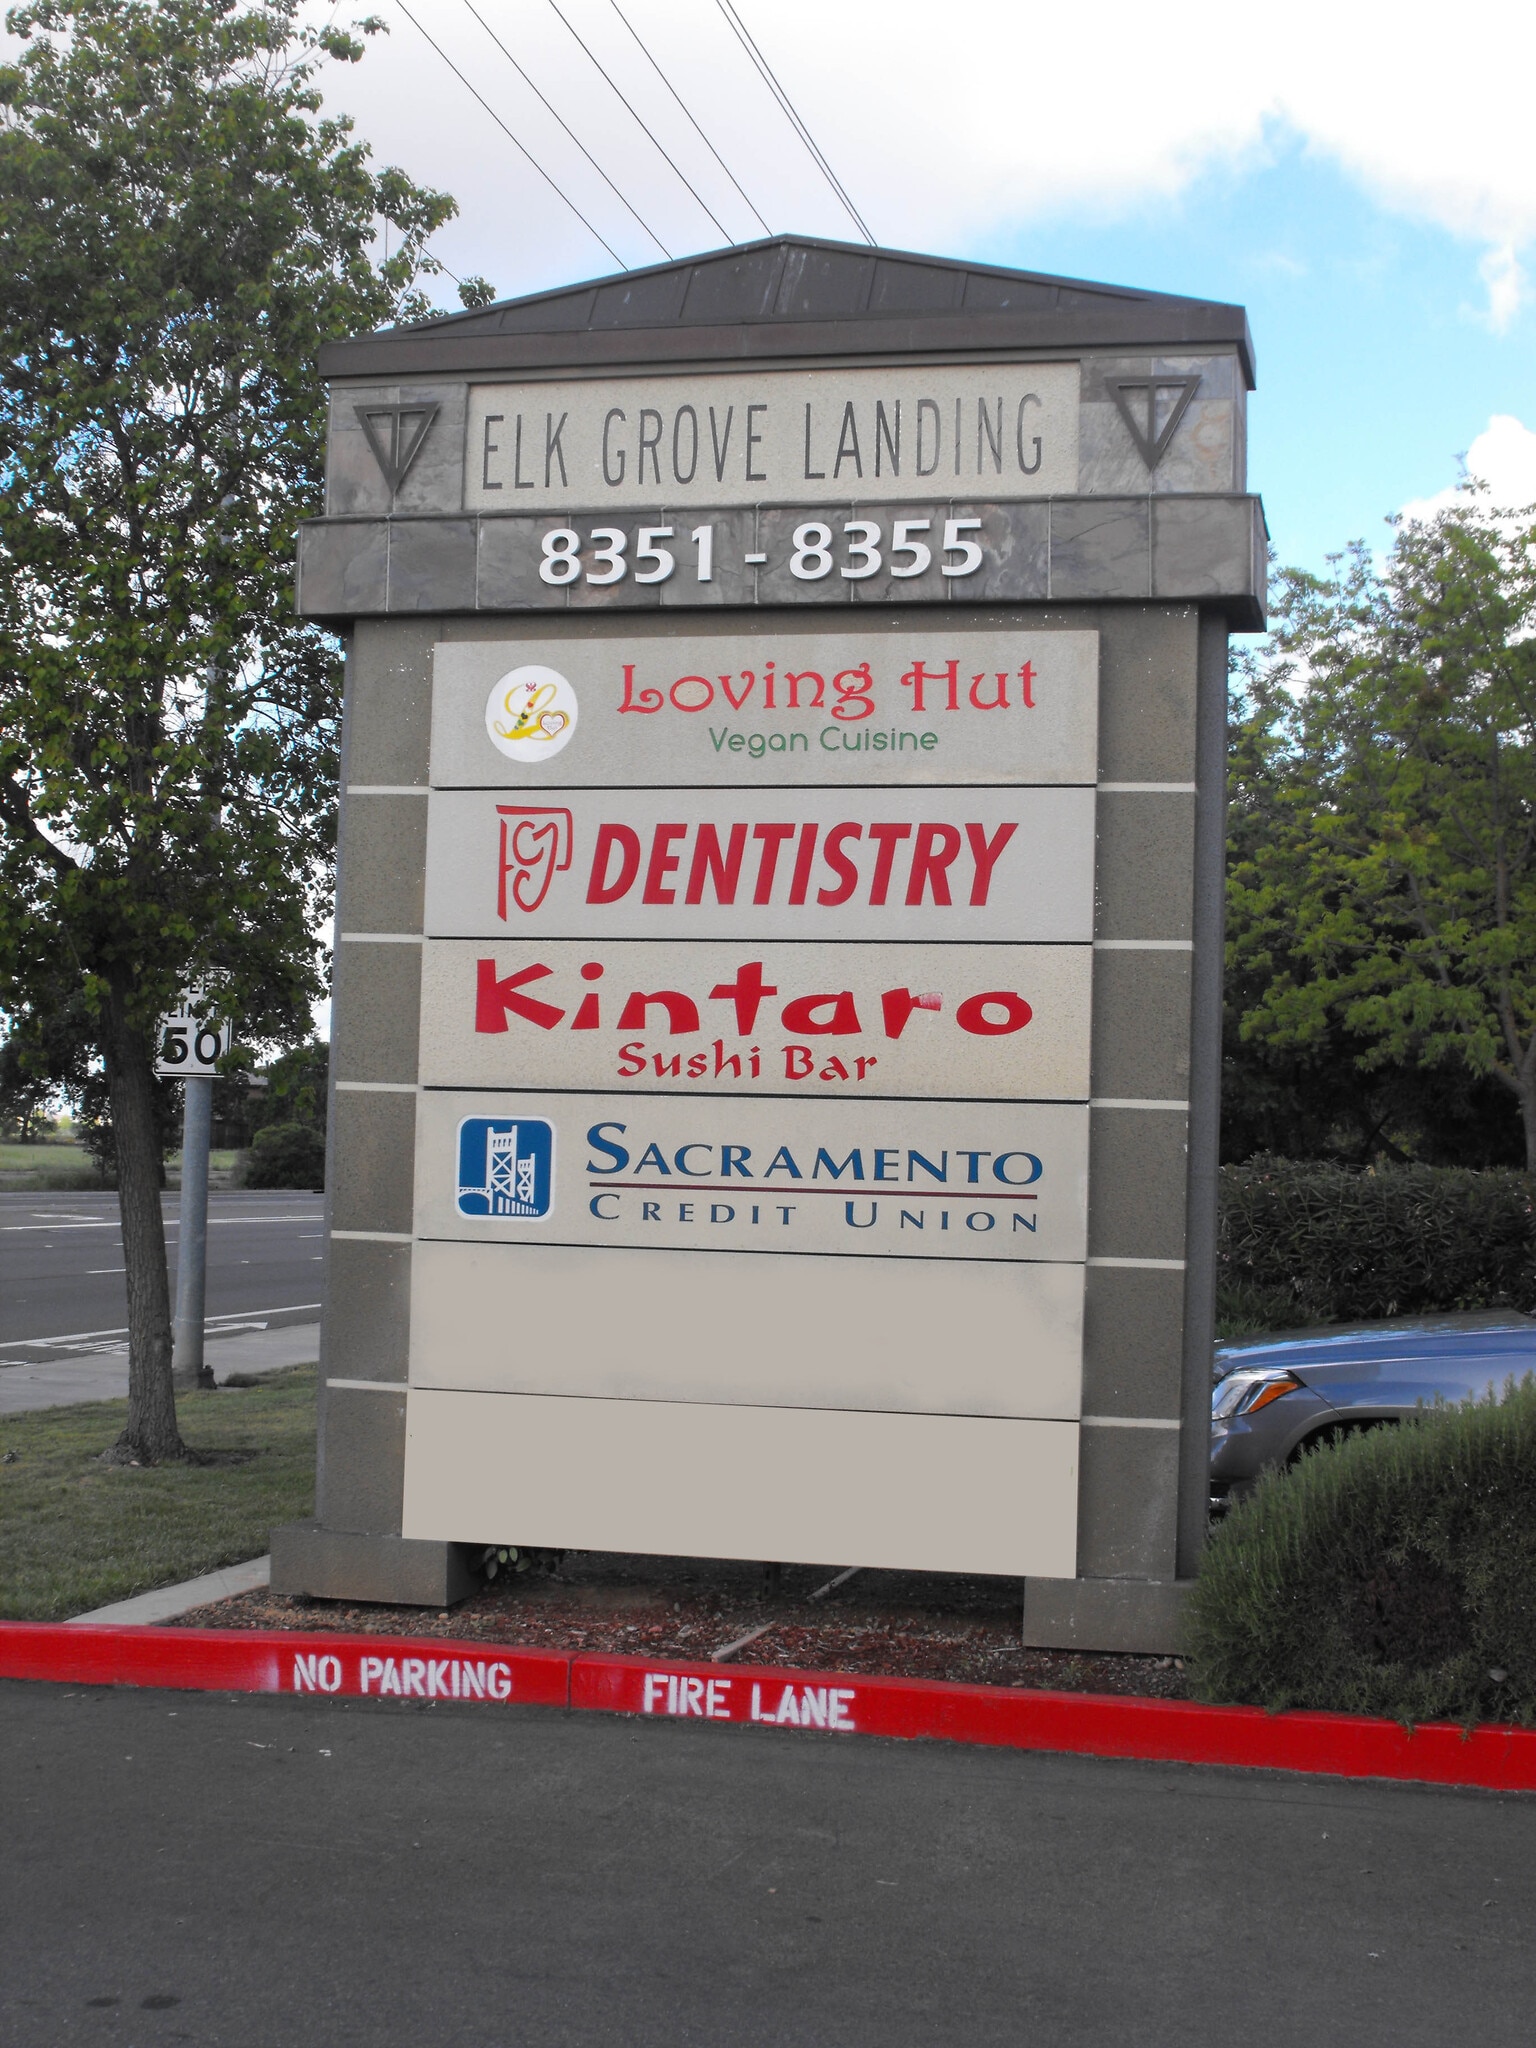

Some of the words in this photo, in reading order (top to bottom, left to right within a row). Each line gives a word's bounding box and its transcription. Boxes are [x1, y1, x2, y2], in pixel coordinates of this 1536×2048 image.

[482, 412, 568, 489] ELK
[602, 404, 767, 487] GROVE
[804, 393, 1042, 480] LANDING
[538, 525, 713, 585] 8351
[789, 518, 983, 580] 8355
[617, 661, 875, 721] Loving
[900, 660, 1037, 712] Hut
[708, 726, 808, 759] Vegan
[819, 726, 939, 752] Cuisine
[585, 822, 1020, 906] DENTISTRY
[475, 959, 1034, 1040] Kintaro
[161, 1027, 222, 1066] 50
[617, 1038, 761, 1080] Sushi
[781, 1045, 878, 1082] Bar
[585, 1121, 1044, 1186] SACRAMENTO
[588, 1193, 798, 1226] CREDIT
[844, 1201, 1038, 1233] UNION
[293, 1653, 342, 1693] NO
[360, 1656, 512, 1699] PARKING
[643, 1673, 731, 1718] FIRE
[751, 1683, 856, 1731] LANE
